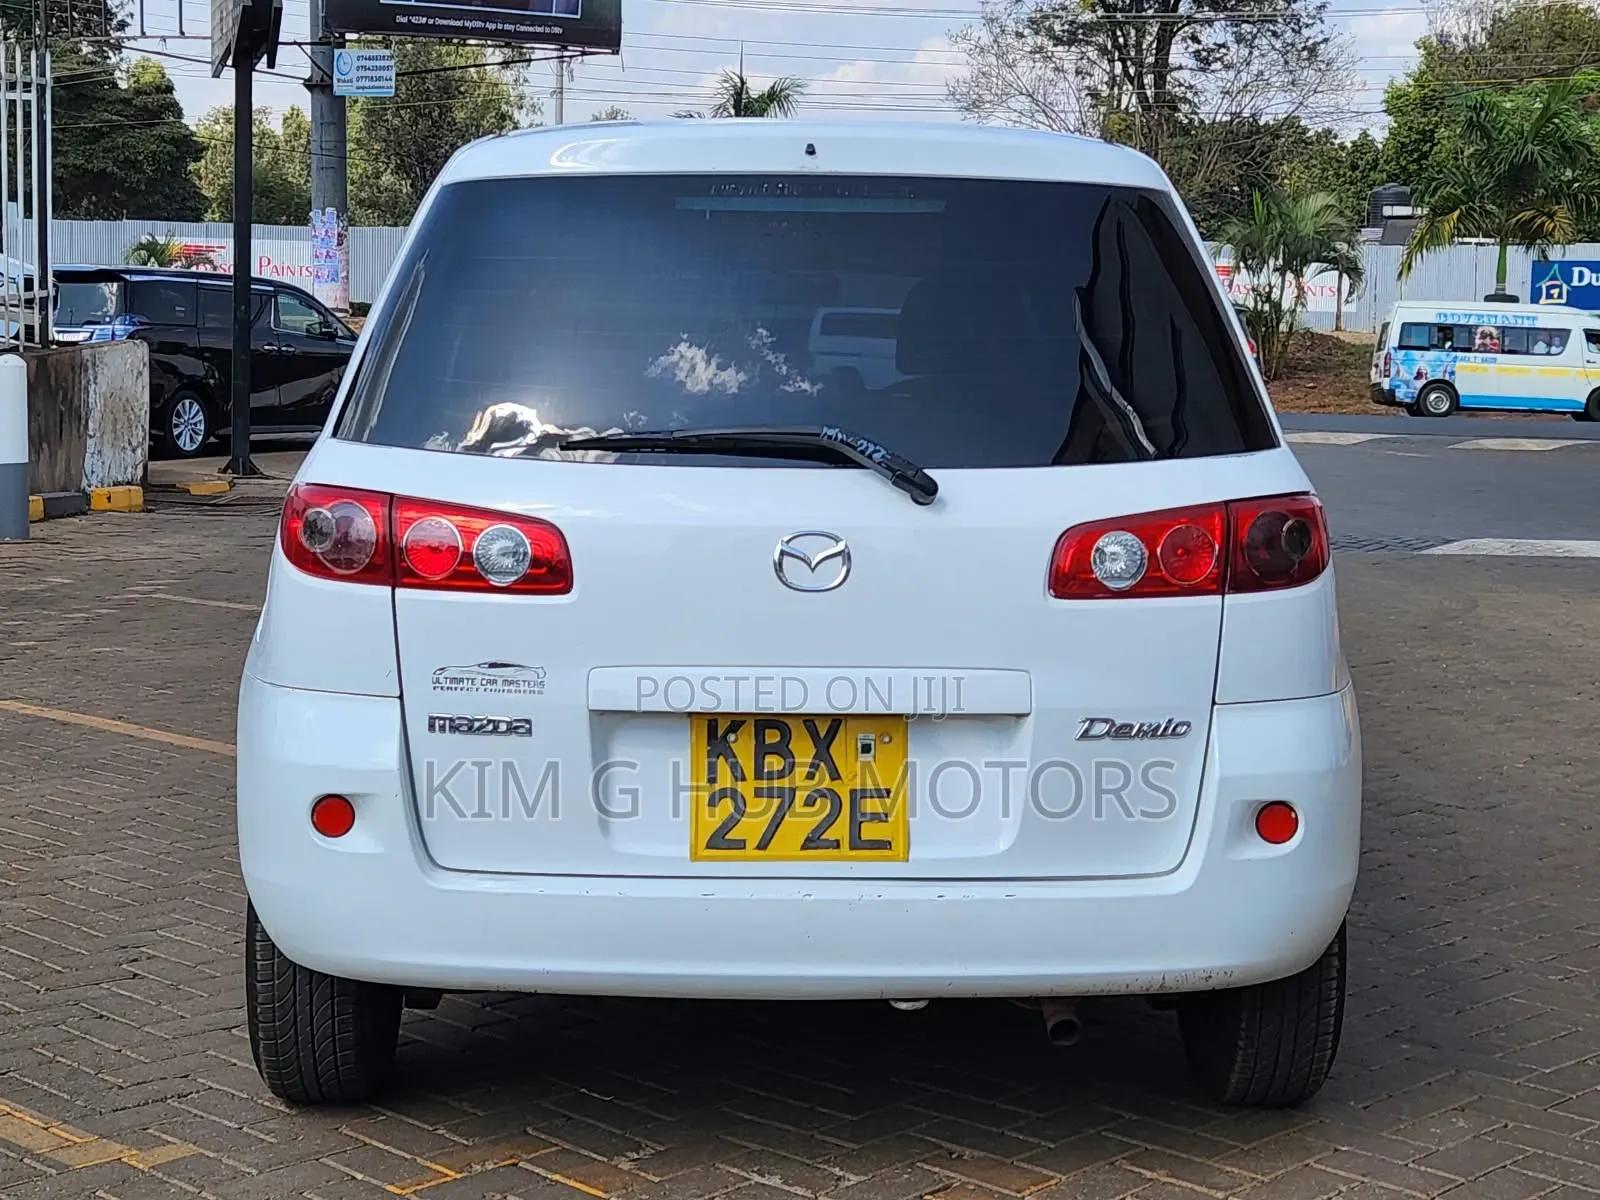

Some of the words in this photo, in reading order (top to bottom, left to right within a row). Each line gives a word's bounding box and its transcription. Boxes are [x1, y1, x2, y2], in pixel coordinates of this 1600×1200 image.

[396, 15, 408, 23] Dial
[435, 17, 463, 27] Download
[486, 22, 497, 31] App
[497, 22, 504, 30] to
[504, 23, 515, 32] stay
[516, 24, 544, 33] Connected
[431, 676, 477, 686] ULTIMATE
[480, 678, 498, 687] CAR
[502, 679, 545, 689] MASTERS
[1074, 717, 1192, 741] Demio
[706, 718, 844, 785] KBX
[703, 786, 893, 851] 272E
